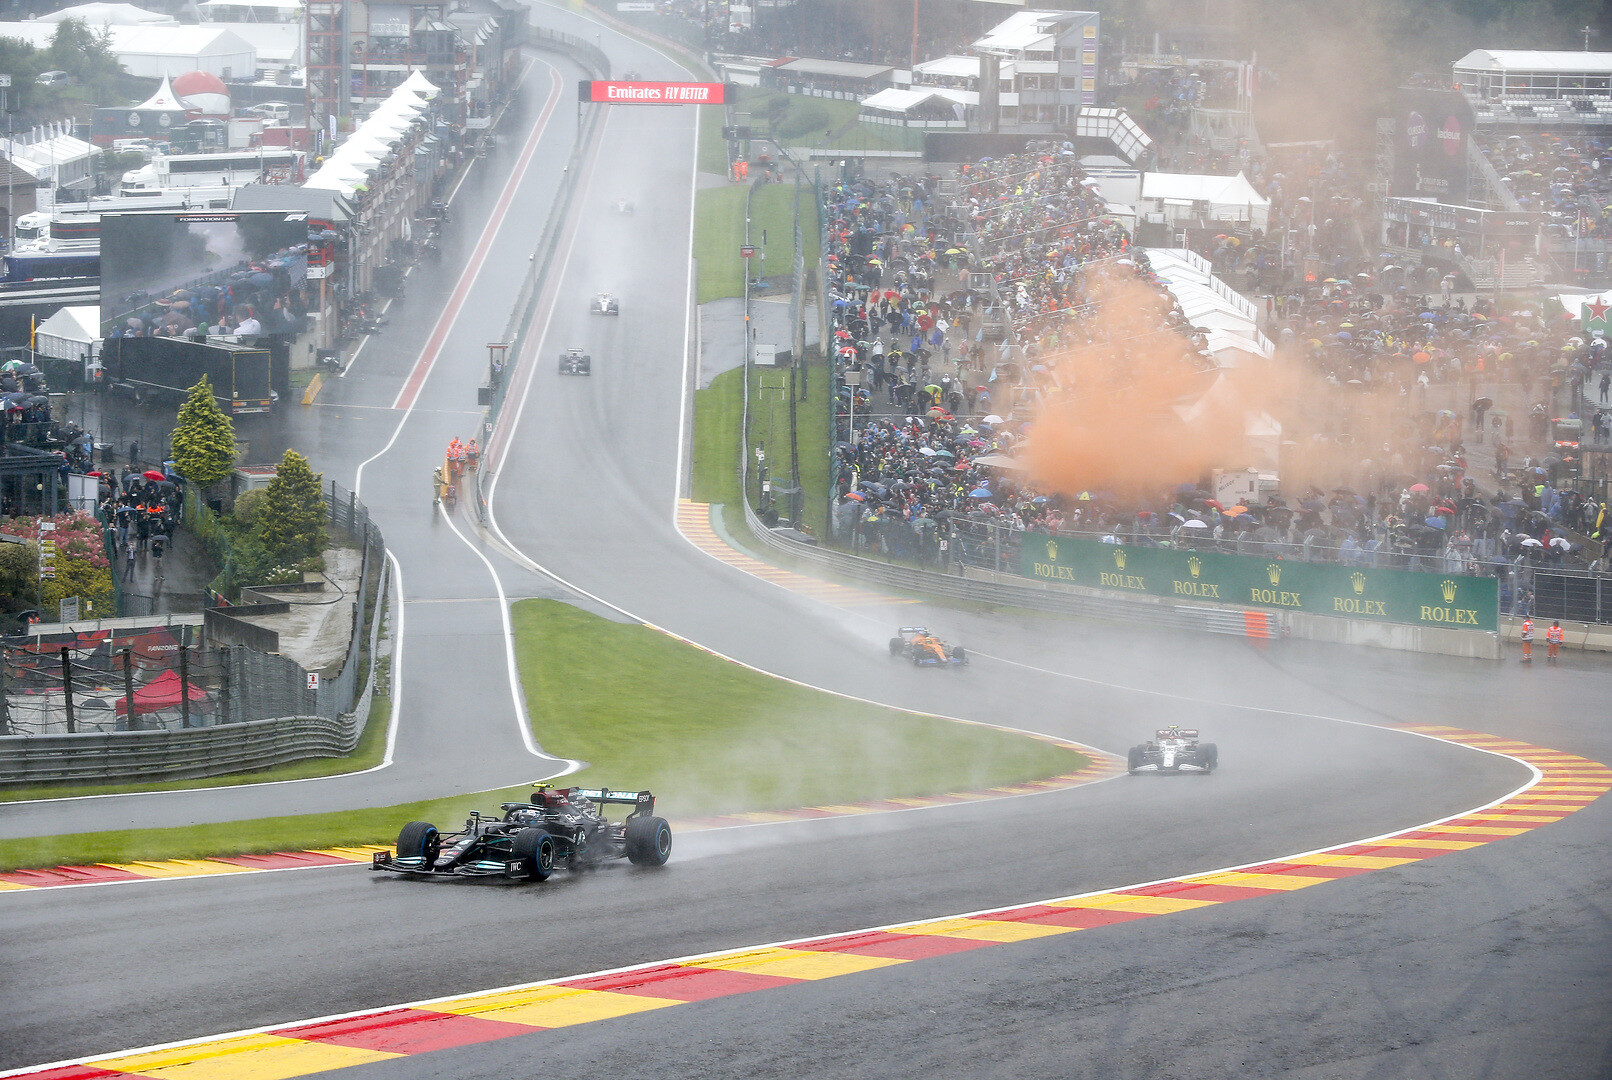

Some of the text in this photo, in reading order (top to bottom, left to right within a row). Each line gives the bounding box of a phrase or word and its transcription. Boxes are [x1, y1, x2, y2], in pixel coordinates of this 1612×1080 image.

[607, 85, 709, 100] Emirates FLY BETTER
[1034, 562, 1076, 581] ROLEX
[1100, 572, 1147, 590] ROLEX
[1173, 580, 1220, 599] ROLEX
[1251, 588, 1302, 607] ROLEX
[1333, 597, 1387, 616] ROLEX
[1420, 605, 1479, 625] ROLEX
[147, 644, 179, 652] FANZONE
[510, 862, 522, 872] IWC
